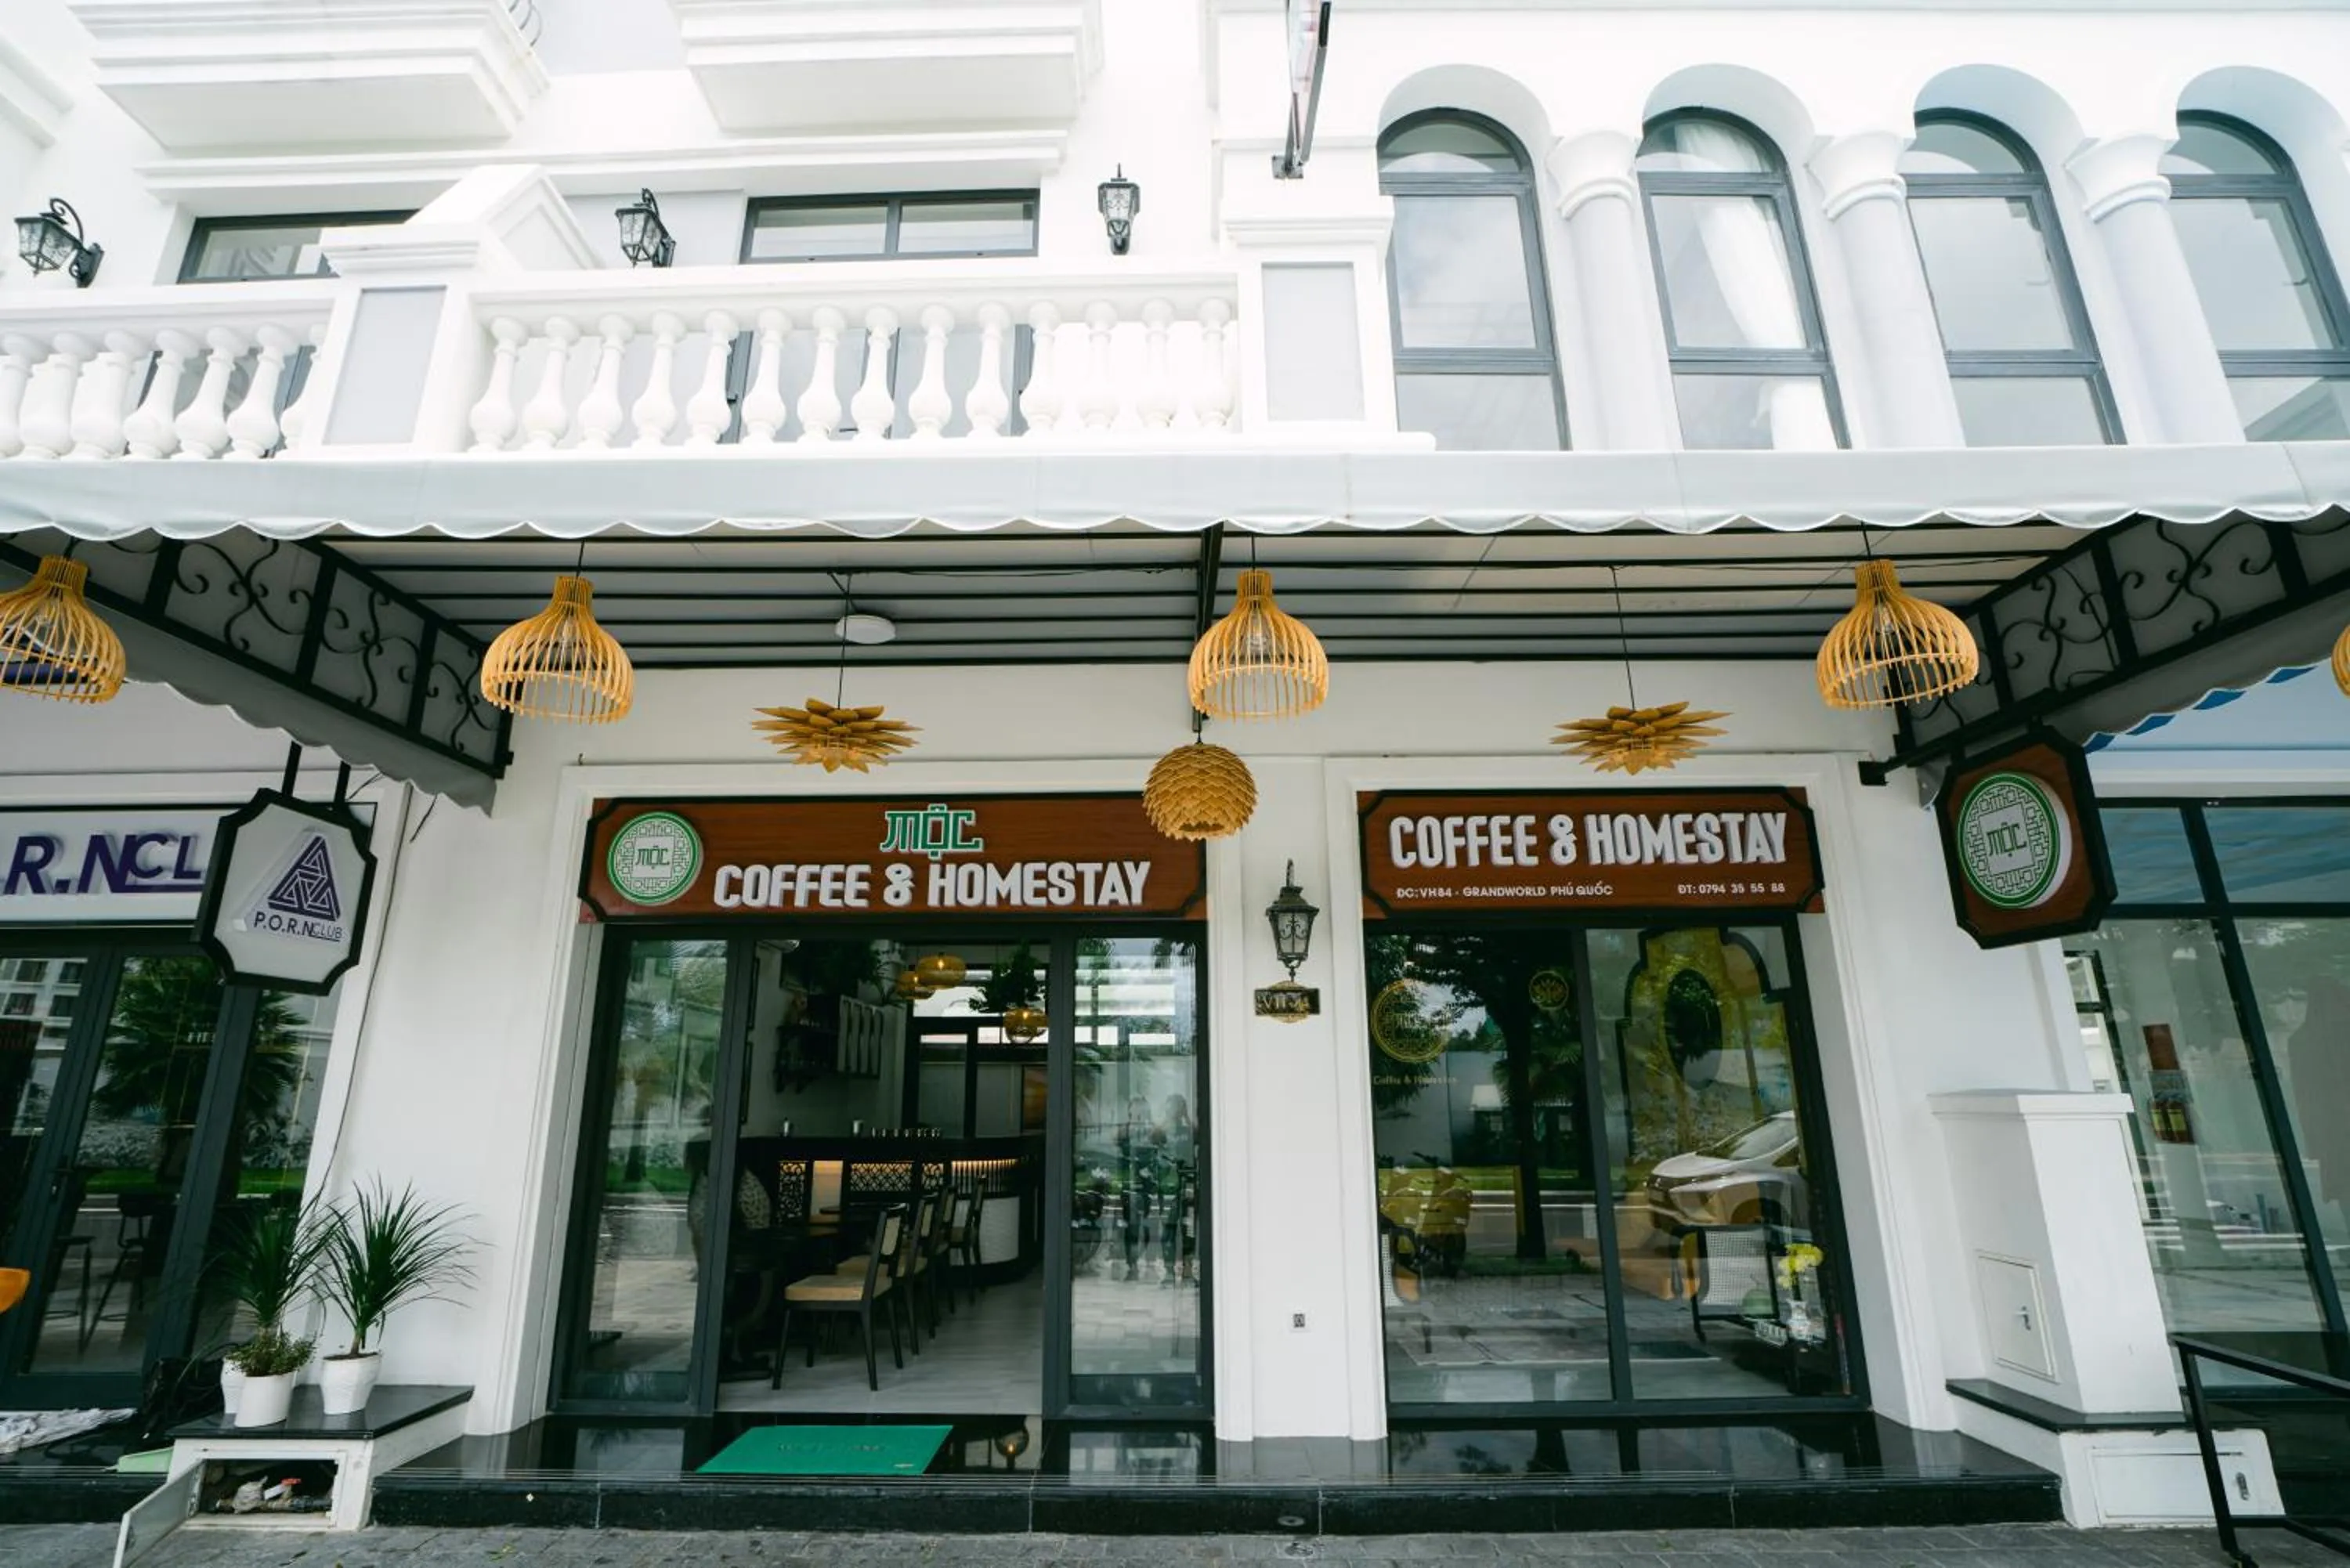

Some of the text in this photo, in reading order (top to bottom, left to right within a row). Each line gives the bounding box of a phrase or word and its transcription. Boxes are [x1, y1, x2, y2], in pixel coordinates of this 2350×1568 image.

[880, 803, 984, 860] MỘC
[1390, 812, 1787, 869] COFFEE & HOMESTAY
[714, 862, 1151, 908] COFFEE & HOMESTAY
[1462, 886, 1546, 897] GRANDWORLD
[1550, 881, 1574, 896] PHÚ
